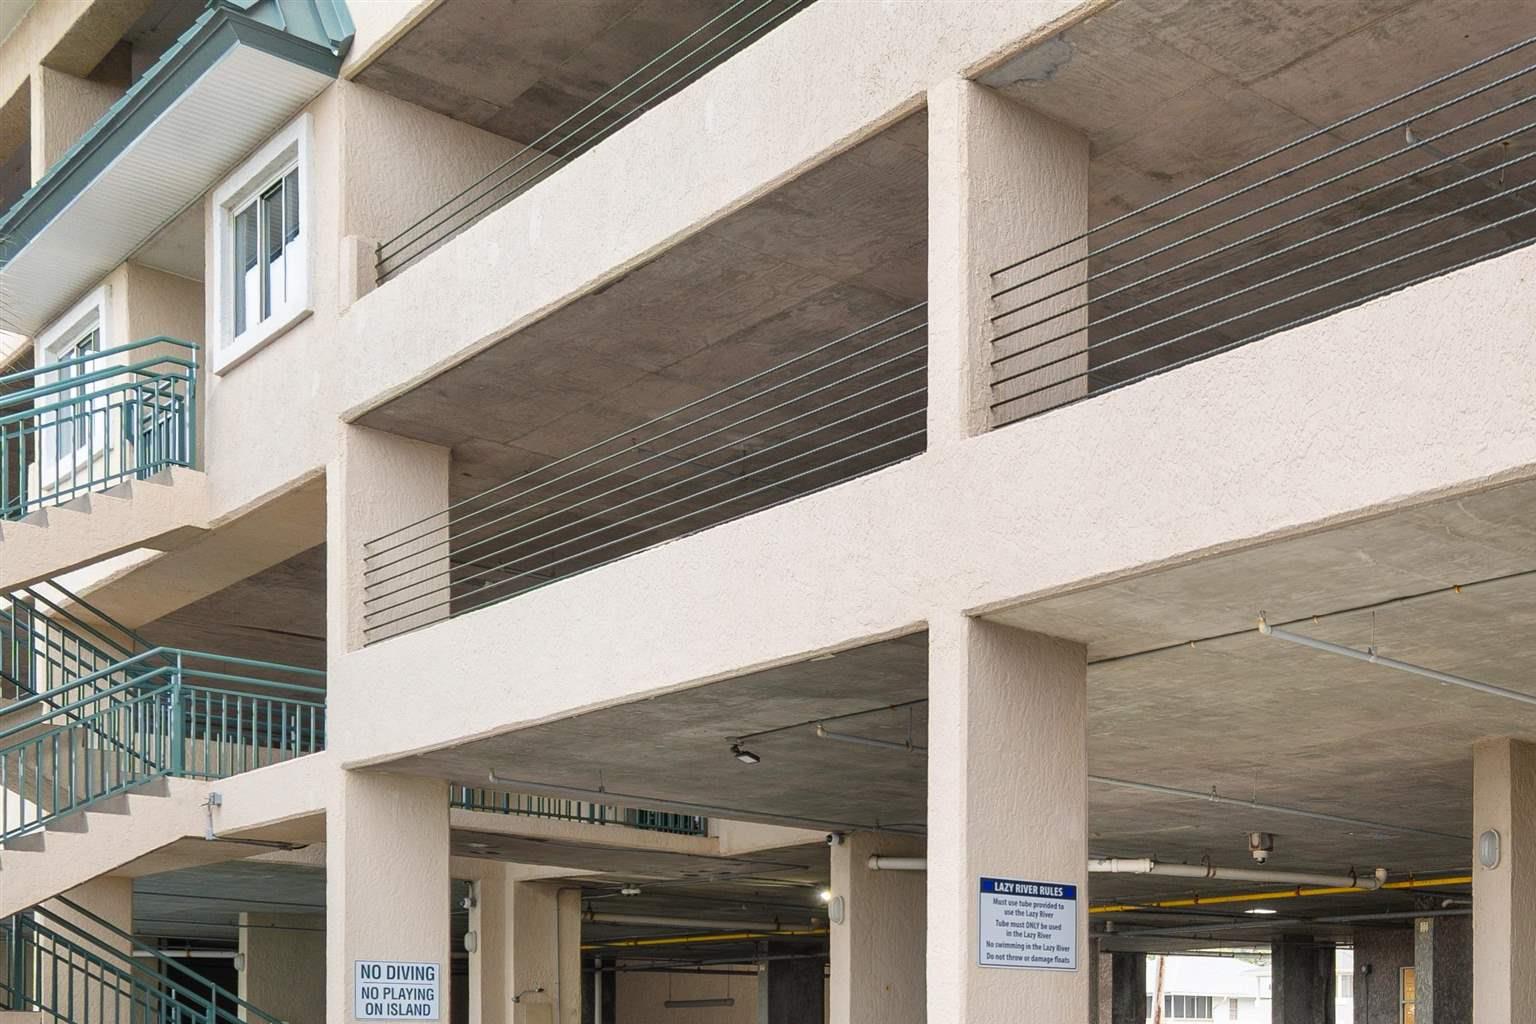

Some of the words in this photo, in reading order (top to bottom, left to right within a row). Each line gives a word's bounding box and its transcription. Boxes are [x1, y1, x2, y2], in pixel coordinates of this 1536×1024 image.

[994, 882, 1014, 892] LAZY
[1016, 884, 1038, 894] RIVER
[1040, 886, 1063, 896] RULES
[1026, 910, 1038, 918] Lazy
[995, 942, 1024, 951] swimming
[1031, 955, 1053, 964] damage
[361, 964, 381, 979] NO
[386, 965, 434, 980] DIVING
[362, 987, 379, 999] NO
[384, 987, 434, 1000] PLAYING
[366, 1003, 382, 1015] ON
[388, 1003, 431, 1016] ISLAND
